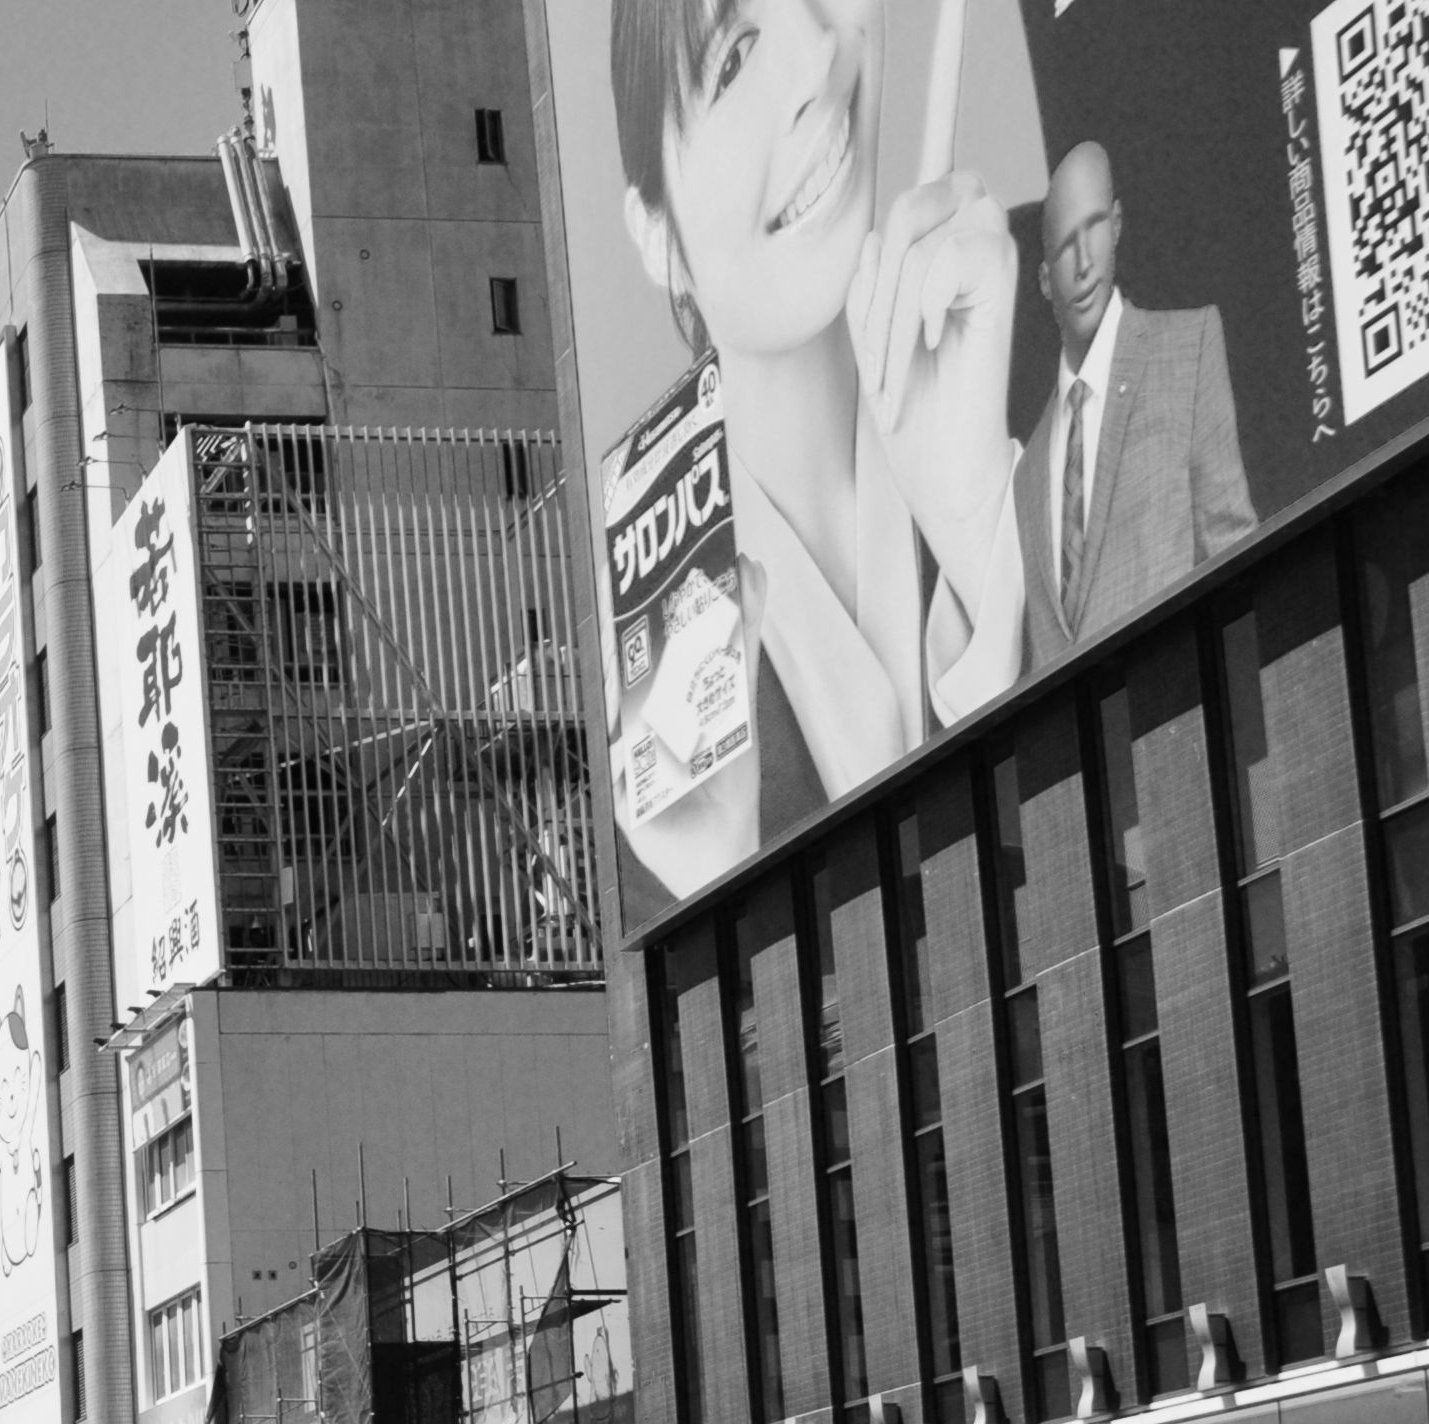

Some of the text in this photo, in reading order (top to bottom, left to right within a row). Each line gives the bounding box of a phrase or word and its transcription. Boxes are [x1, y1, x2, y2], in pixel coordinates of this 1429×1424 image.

[1280, 69, 1336, 443] 詳しい商品情報はこちらへ
[613, 447, 730, 595] サロンパス
